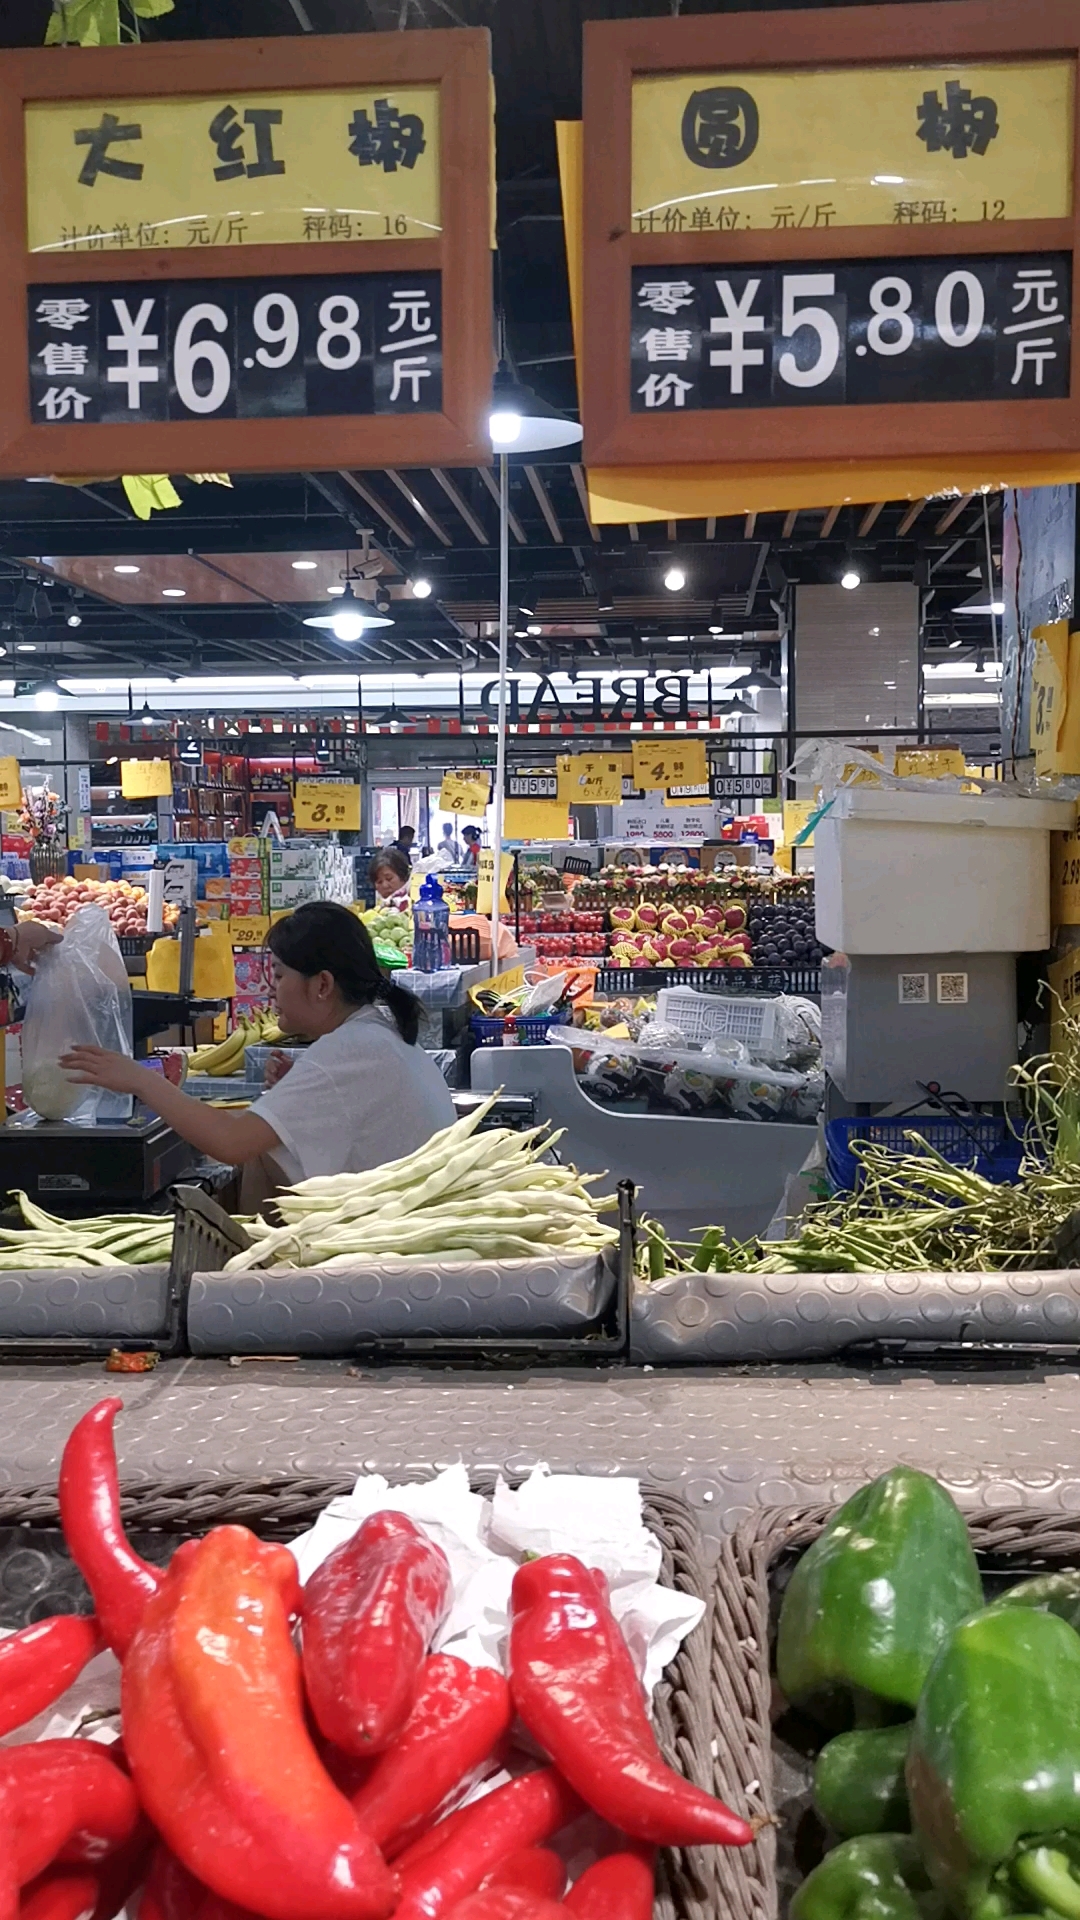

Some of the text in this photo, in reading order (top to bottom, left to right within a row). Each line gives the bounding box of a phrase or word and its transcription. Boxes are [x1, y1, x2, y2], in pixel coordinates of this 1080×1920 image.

[74, 100, 426, 187] 大红椒
[681, 80, 999, 168] 圆椒
[36, 298, 92, 421] 零售价
[380, 290, 438, 403] 元/斤
[637, 279, 695, 408] 零售价
[1003, 269, 1065, 386] 元/斤
